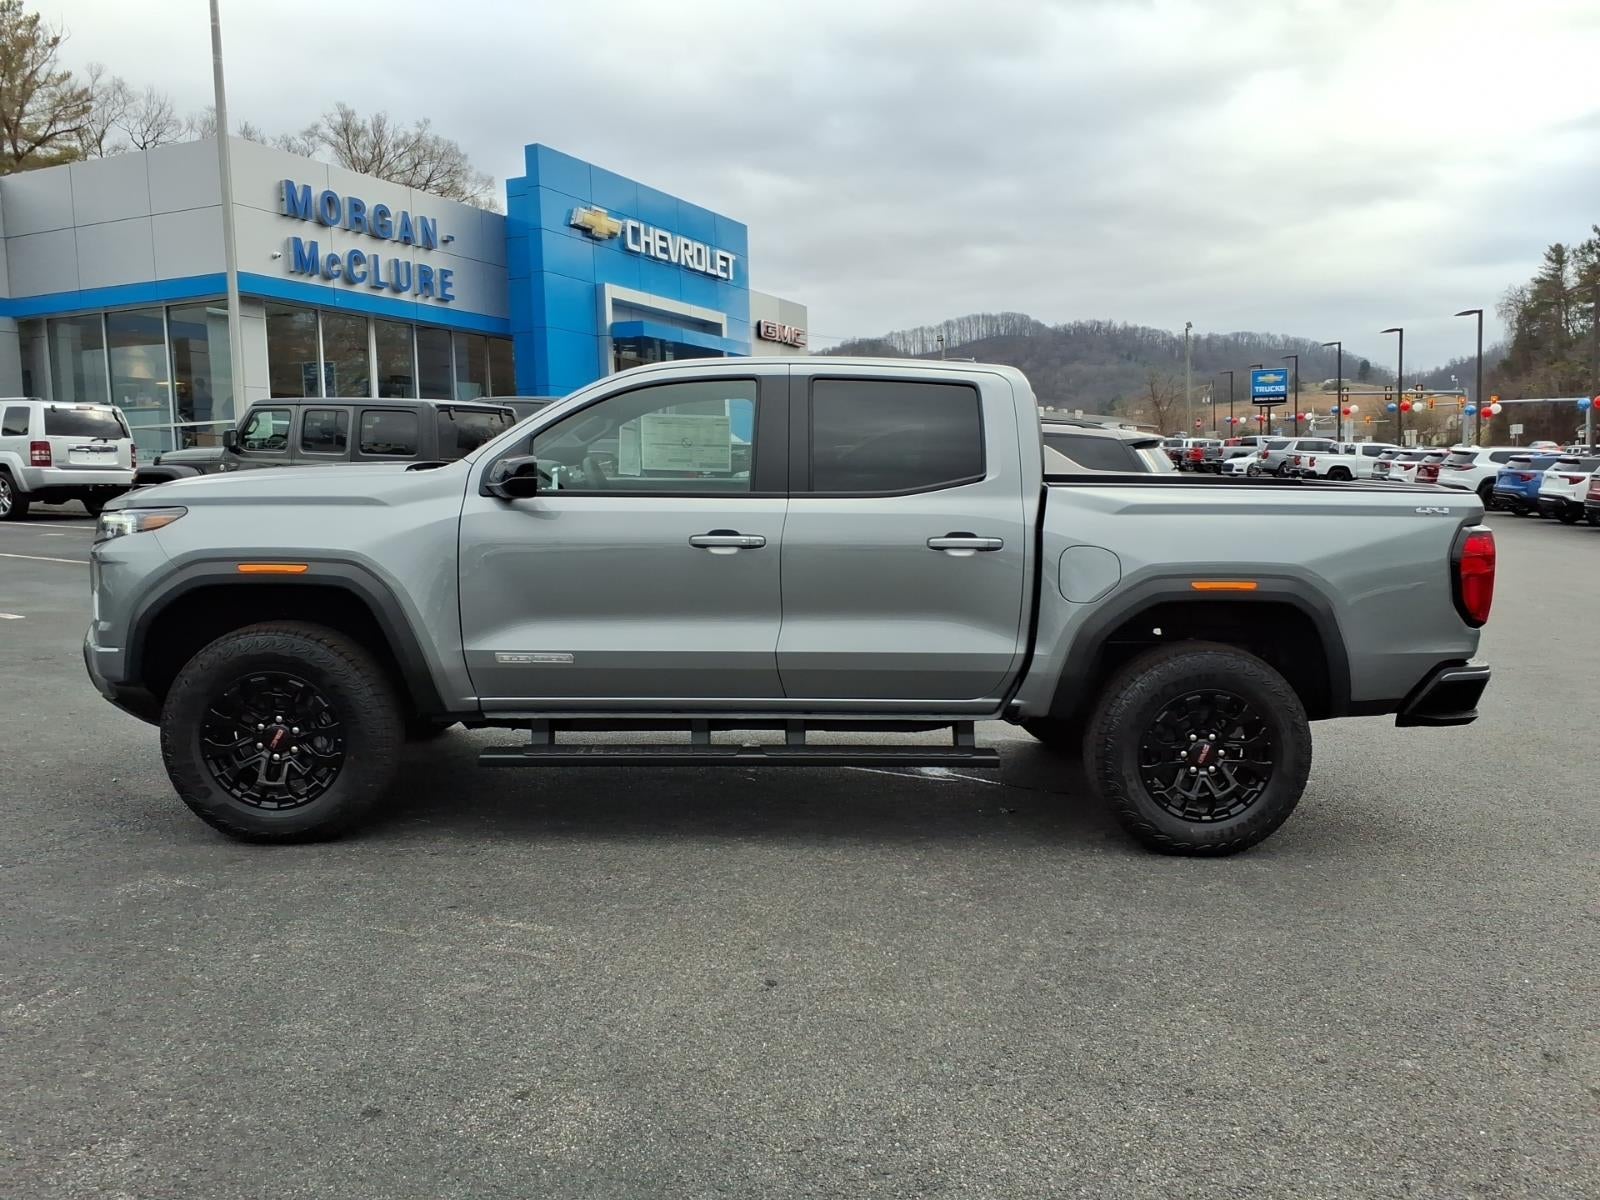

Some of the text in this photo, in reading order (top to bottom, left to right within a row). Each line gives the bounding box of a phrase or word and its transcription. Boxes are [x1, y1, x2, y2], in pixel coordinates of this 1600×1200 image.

[280, 179, 455, 250] MORGAN-
[287, 236, 455, 303] McCLURE
[625, 219, 736, 281] CHEVROLET
[758, 319, 808, 347] GMC
[1254, 385, 1286, 393] TRUCKS
